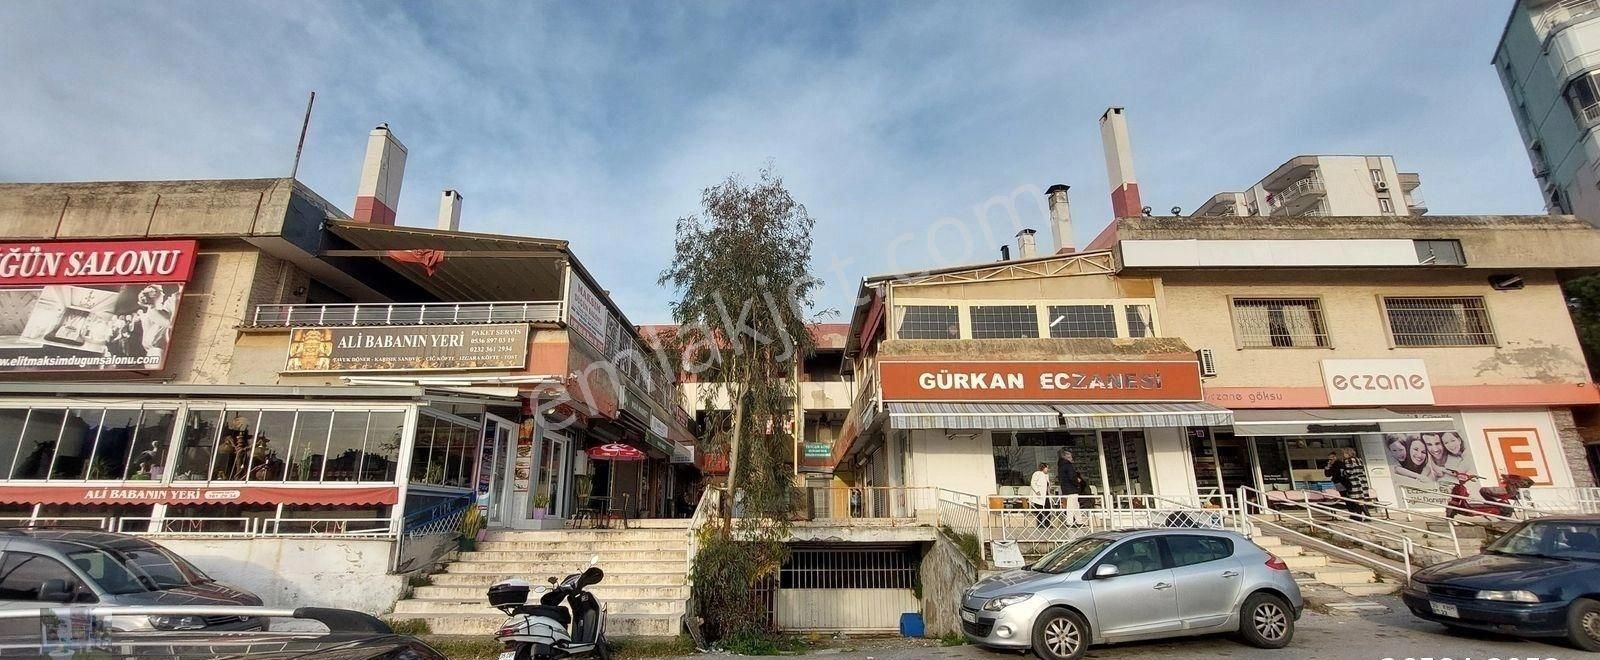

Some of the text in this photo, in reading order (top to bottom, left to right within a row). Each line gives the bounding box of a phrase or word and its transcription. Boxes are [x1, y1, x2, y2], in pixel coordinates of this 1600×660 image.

[64, 250, 181, 277] SALONU
[337, 330, 465, 349] ALİ BABANIN YERİ
[918, 370, 1024, 390] GÜRKAN
[1332, 373, 1425, 392] eczane
[1248, 391, 1283, 403] göksu
[84, 486, 201, 500] ALİ BABANIN YERİ
